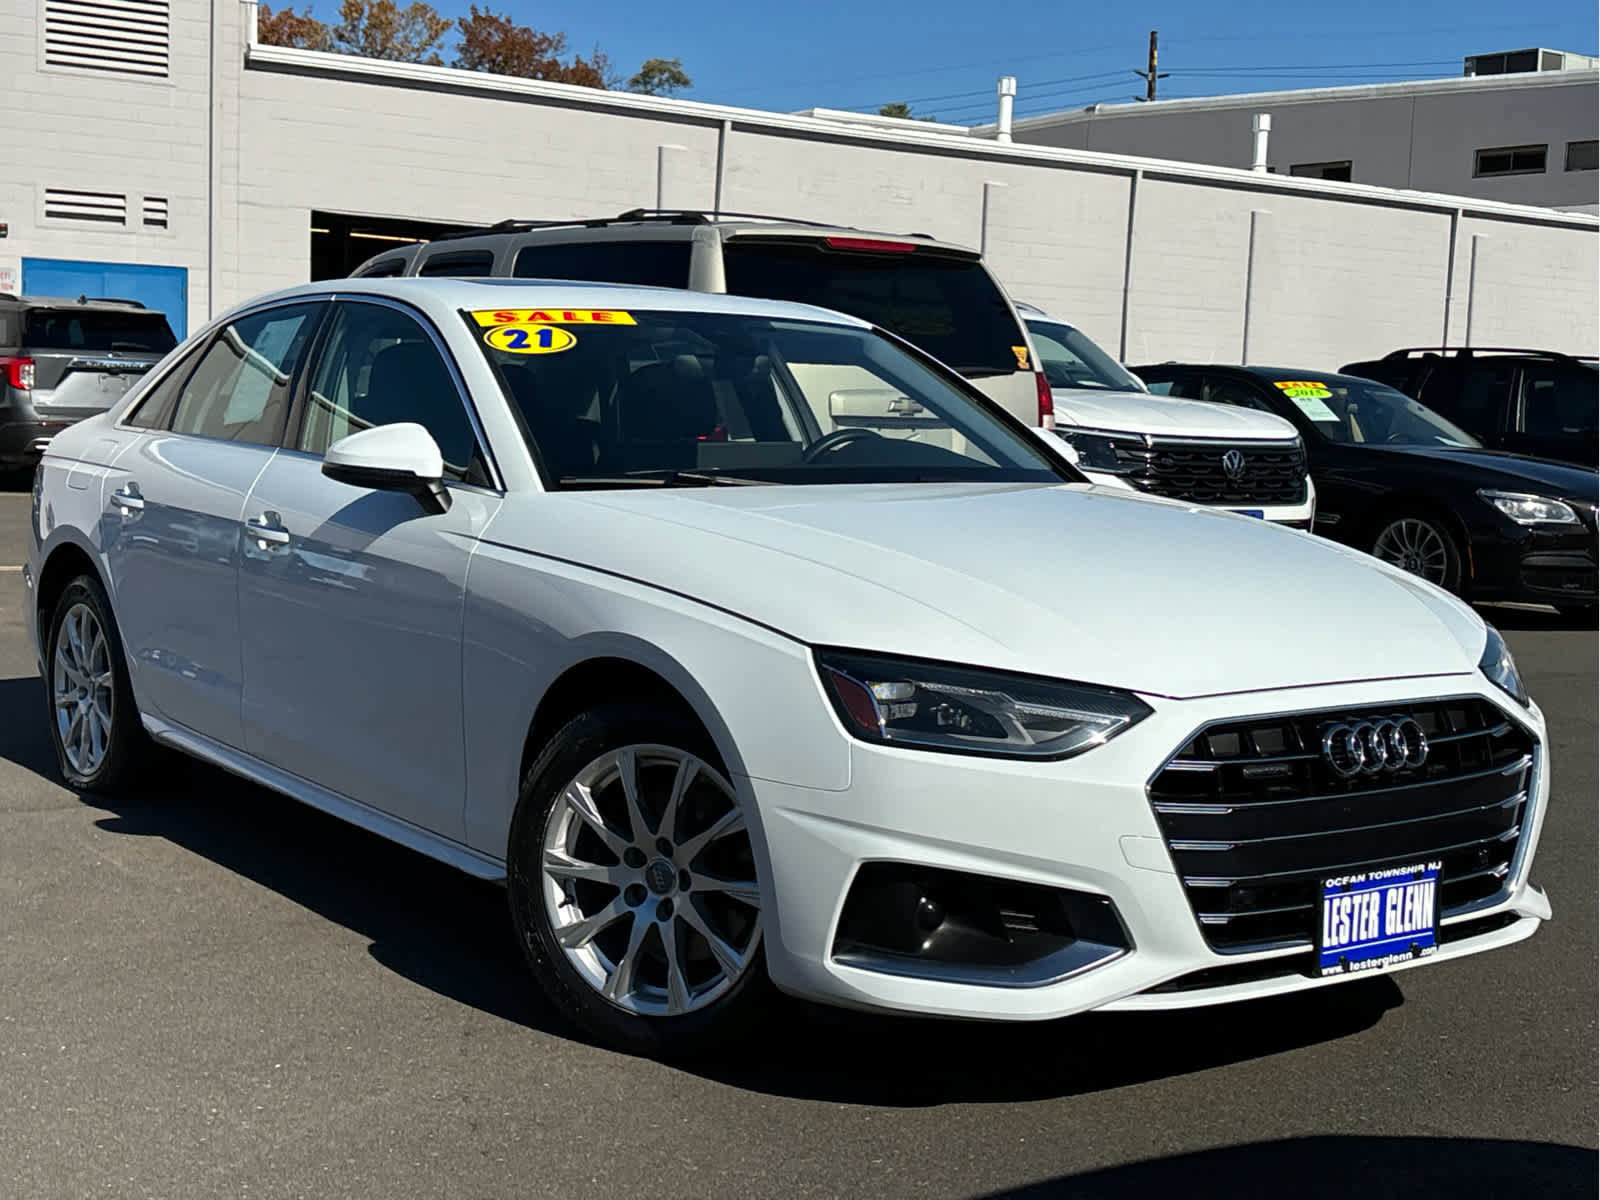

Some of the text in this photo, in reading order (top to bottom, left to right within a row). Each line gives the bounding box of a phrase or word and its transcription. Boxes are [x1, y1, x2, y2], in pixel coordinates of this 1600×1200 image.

[492, 311, 616, 322] SALE
[502, 328, 553, 349] 21
[1427, 861, 1442, 871] NJ
[1322, 881, 1435, 948] LESTER GLENN
